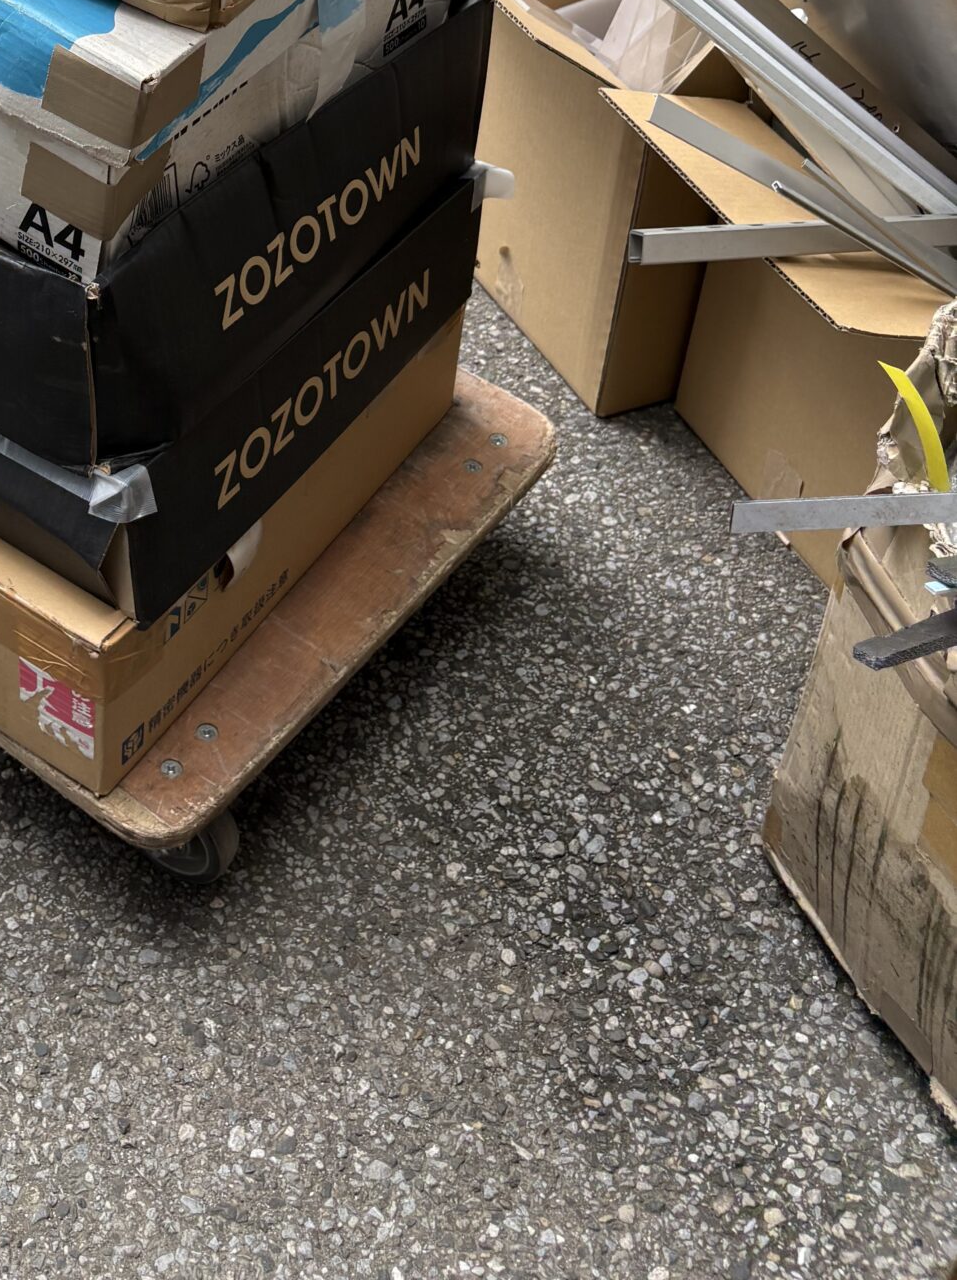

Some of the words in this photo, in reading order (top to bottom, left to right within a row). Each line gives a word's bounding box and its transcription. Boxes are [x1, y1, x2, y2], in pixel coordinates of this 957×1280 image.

[19, 203, 85, 261] A4
[214, 125, 421, 331] ZOZOTOWN
[214, 268, 430, 511] ZOZOTOWN
